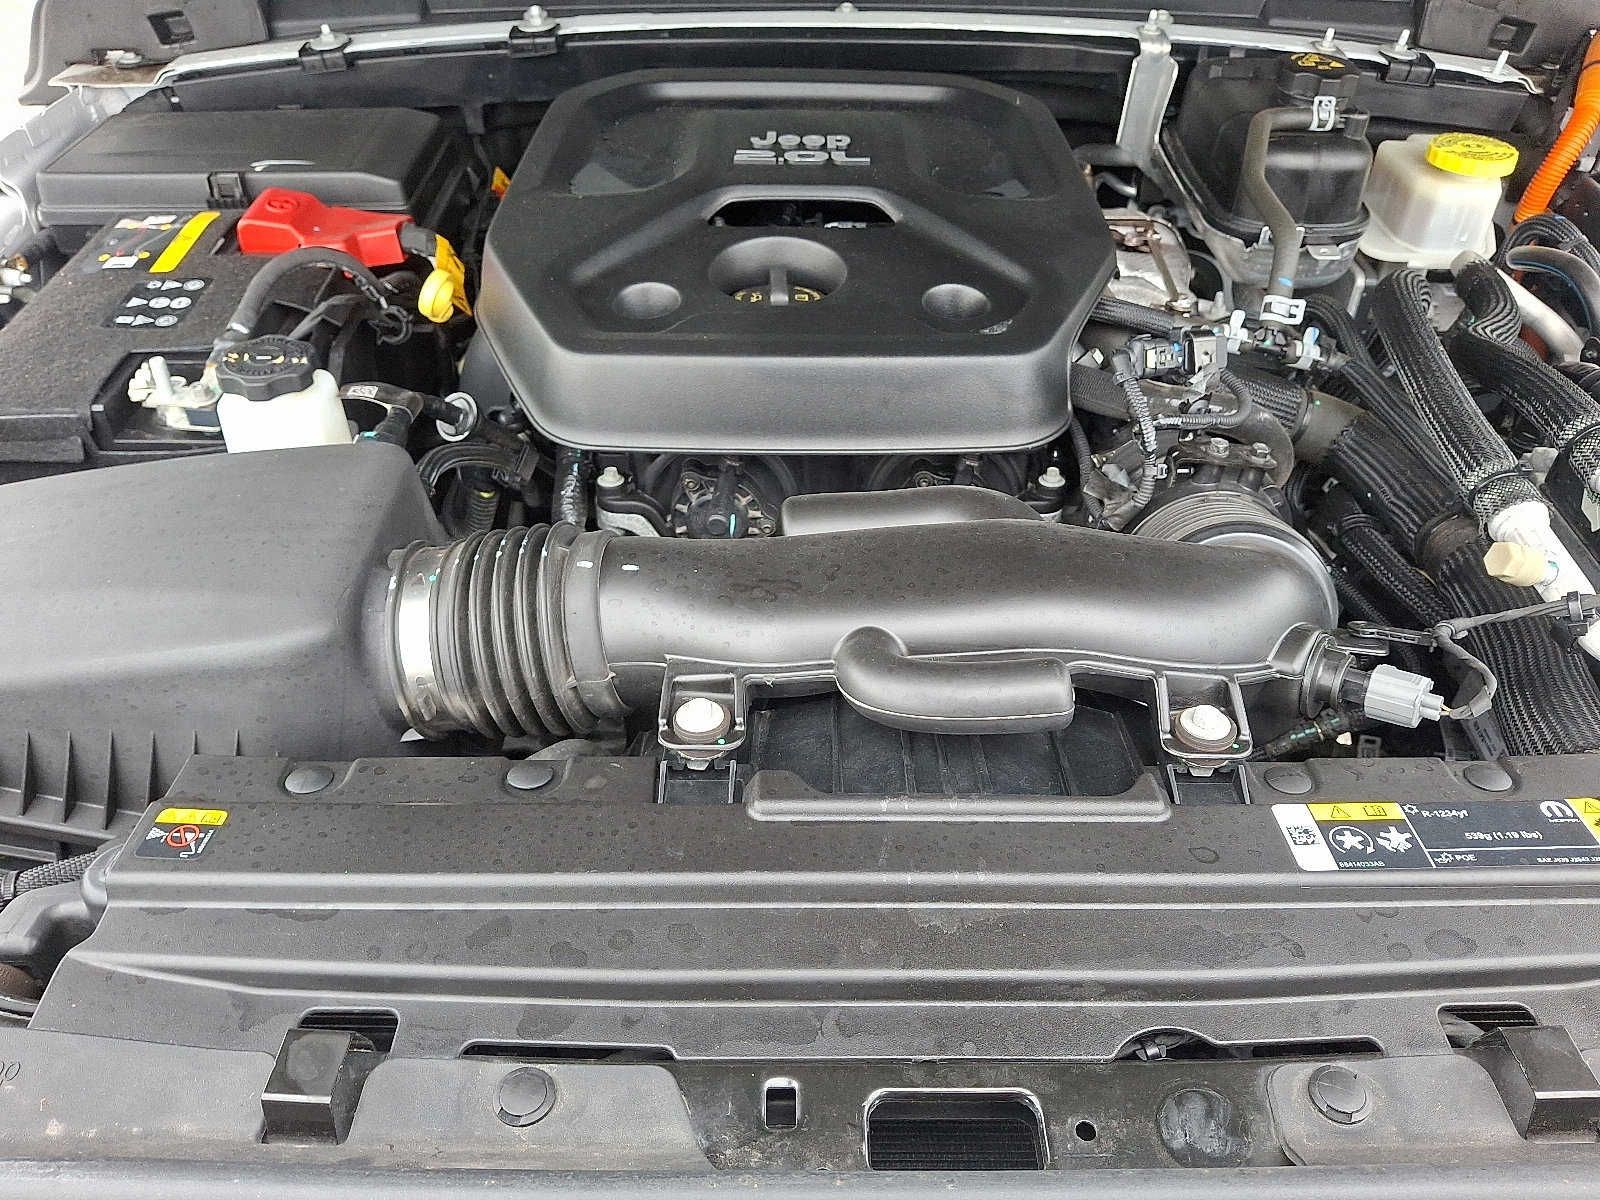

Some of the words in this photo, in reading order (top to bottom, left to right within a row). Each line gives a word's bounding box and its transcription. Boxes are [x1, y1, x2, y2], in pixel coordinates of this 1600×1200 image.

[750, 131, 851, 149] Jeep
[733, 149, 871, 166] 2.0L
[1464, 831, 1493, 841] 539g
[1455, 853, 1478, 862] POE
